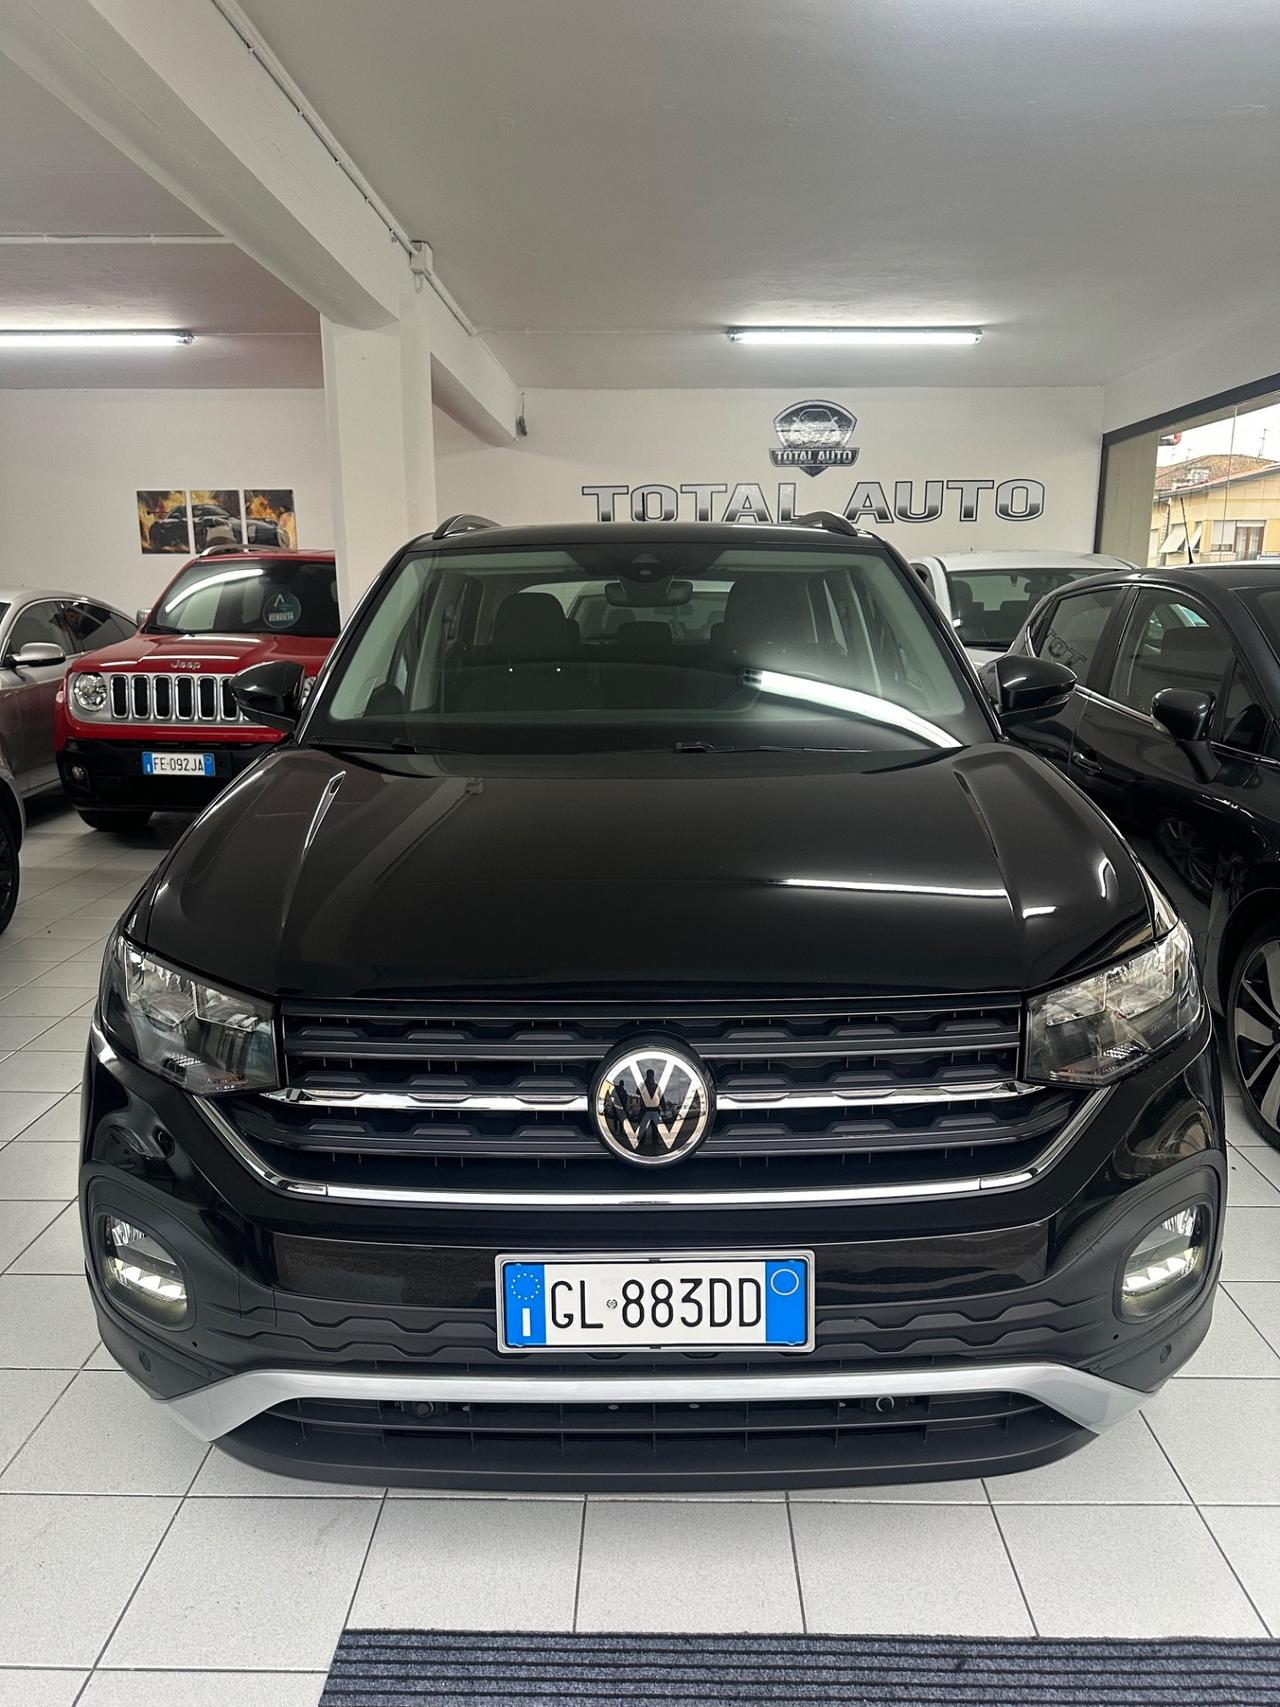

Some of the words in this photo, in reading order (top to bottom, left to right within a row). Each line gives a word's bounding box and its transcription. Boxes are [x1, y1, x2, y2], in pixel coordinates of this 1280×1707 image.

[776, 450, 813, 464] TOTAL
[817, 450, 852, 464] AUTO
[581, 482, 803, 523] TOTAL
[842, 478, 1046, 524] AUTO
[170, 659, 201, 670] Jeep
[621, 1277, 762, 1329] 883DD
